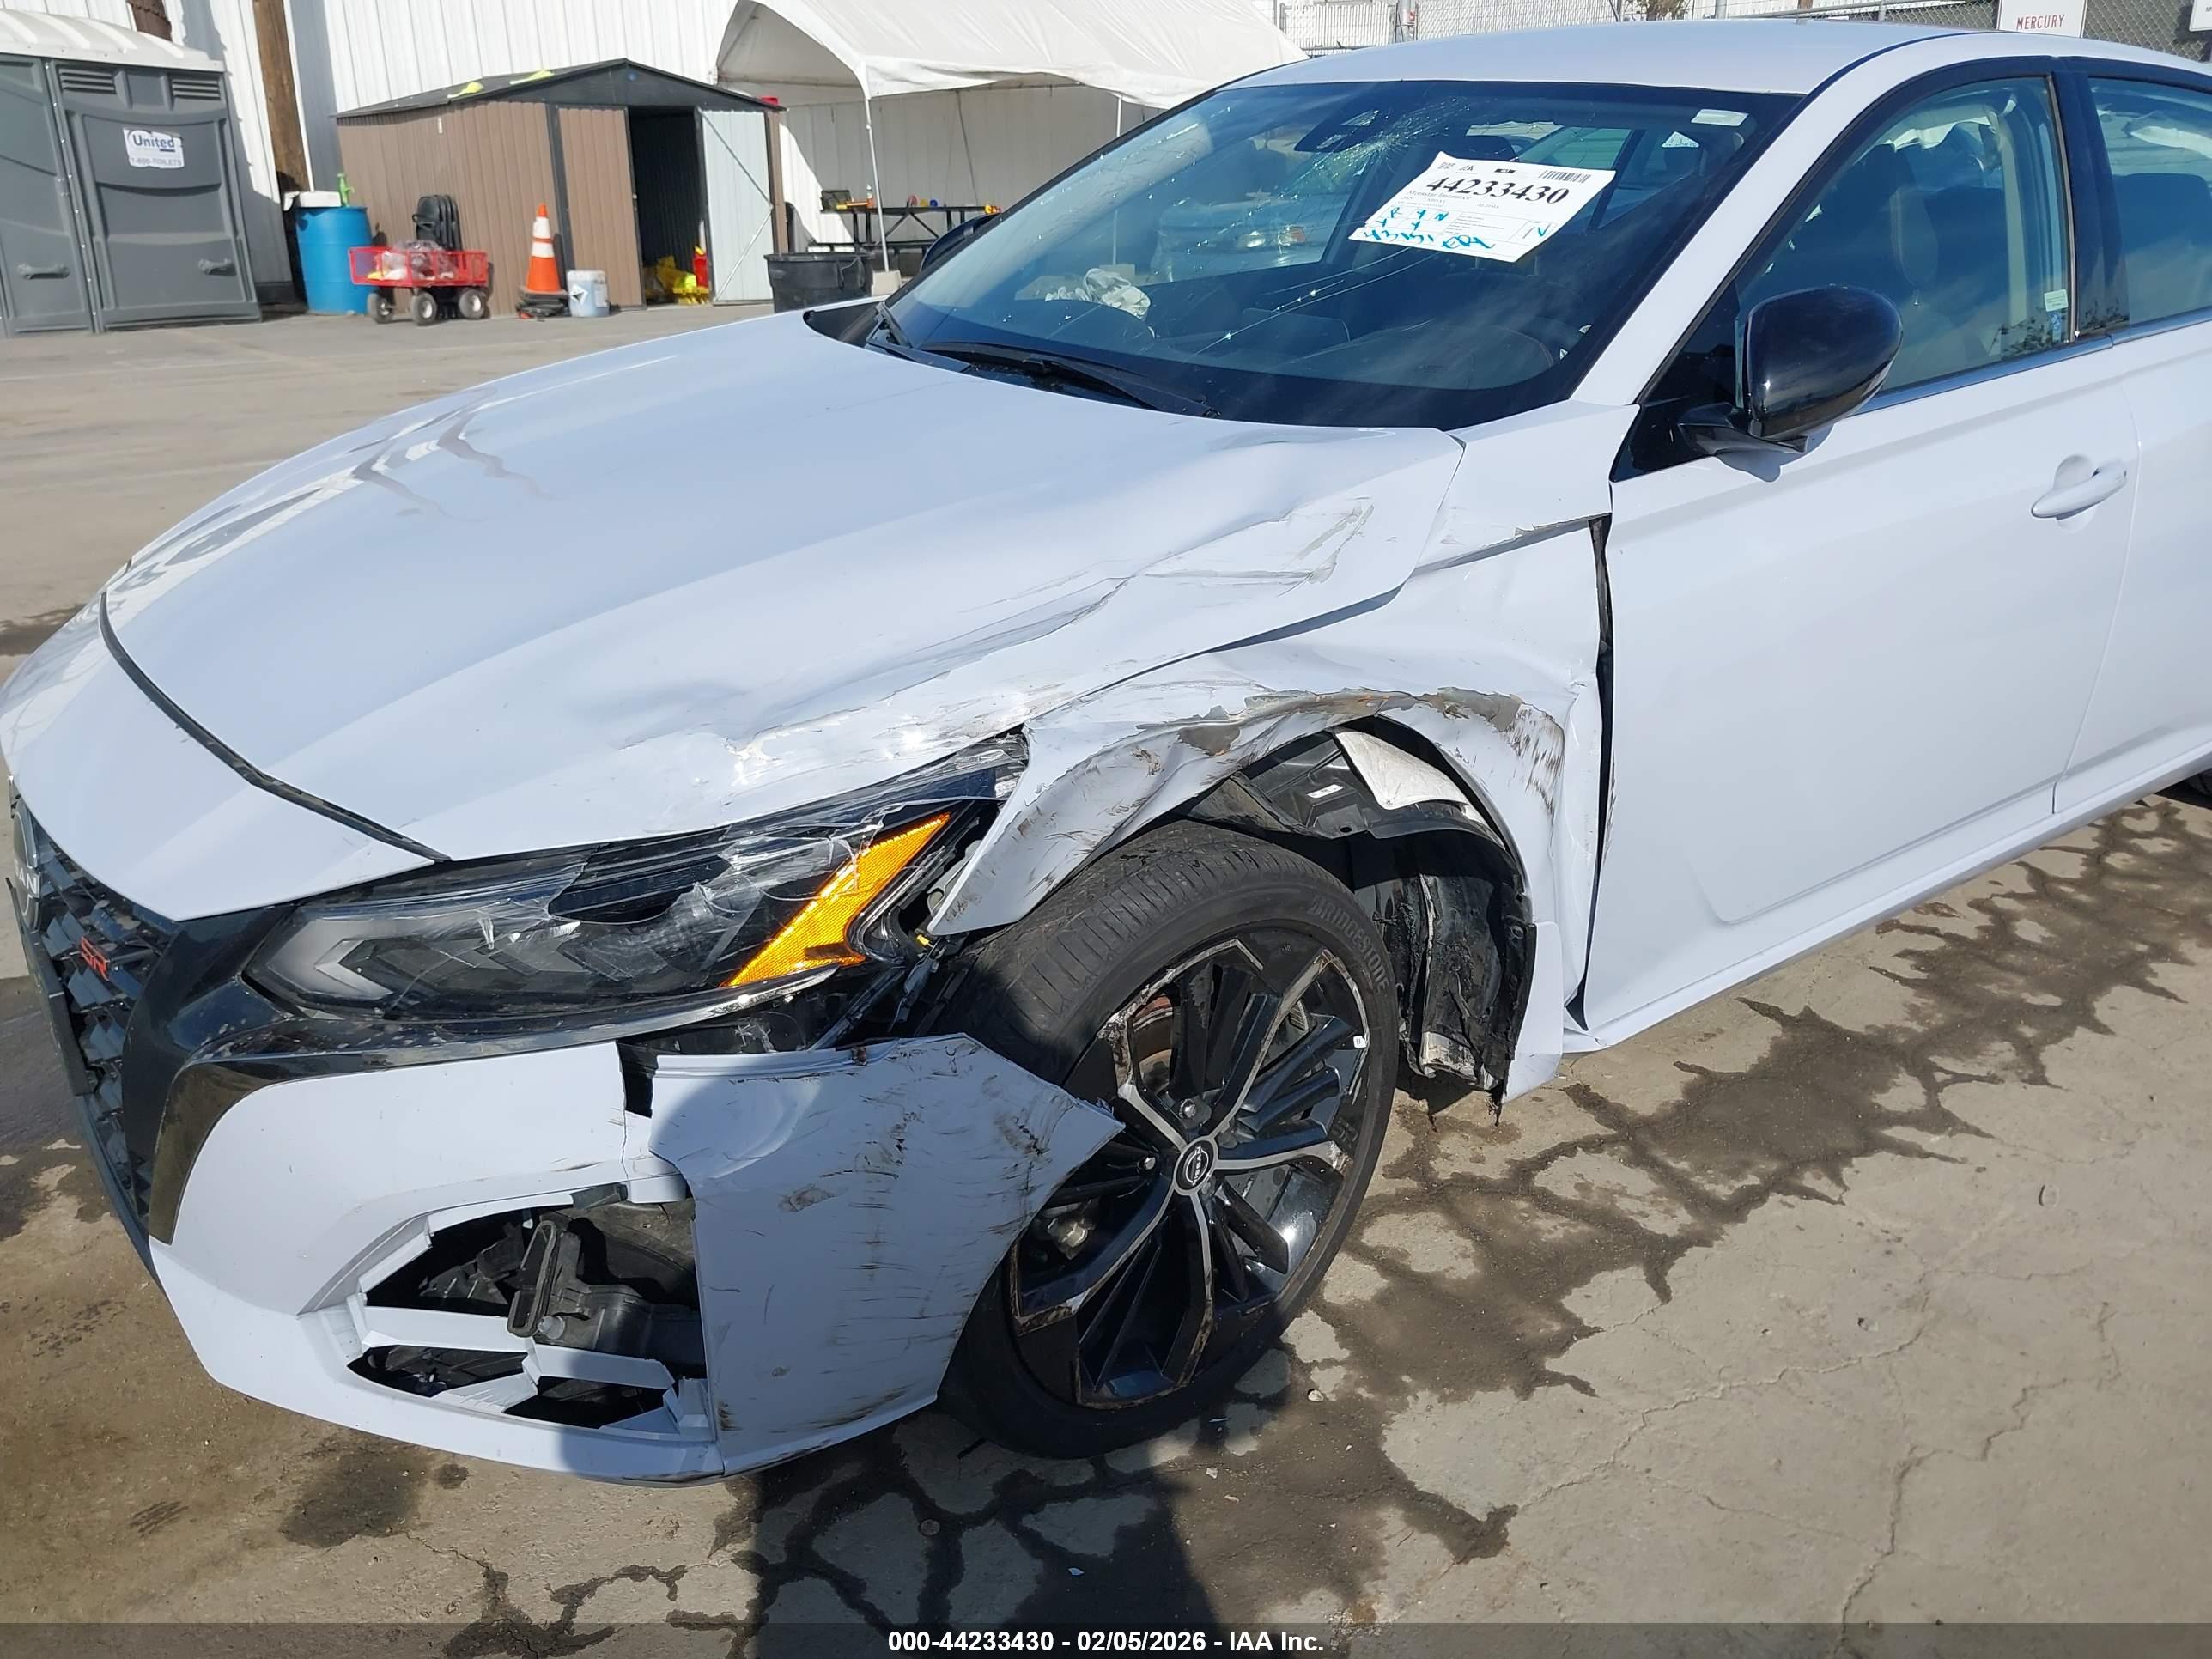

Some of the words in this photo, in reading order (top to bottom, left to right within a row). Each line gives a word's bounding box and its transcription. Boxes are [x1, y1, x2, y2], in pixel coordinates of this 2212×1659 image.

[2016, 14, 2065, 30] MERCURY
[132, 134, 175, 149] United
[1426, 176, 1570, 204] 44233430
[1307, 894, 1389, 994] BRIDGESTONE
